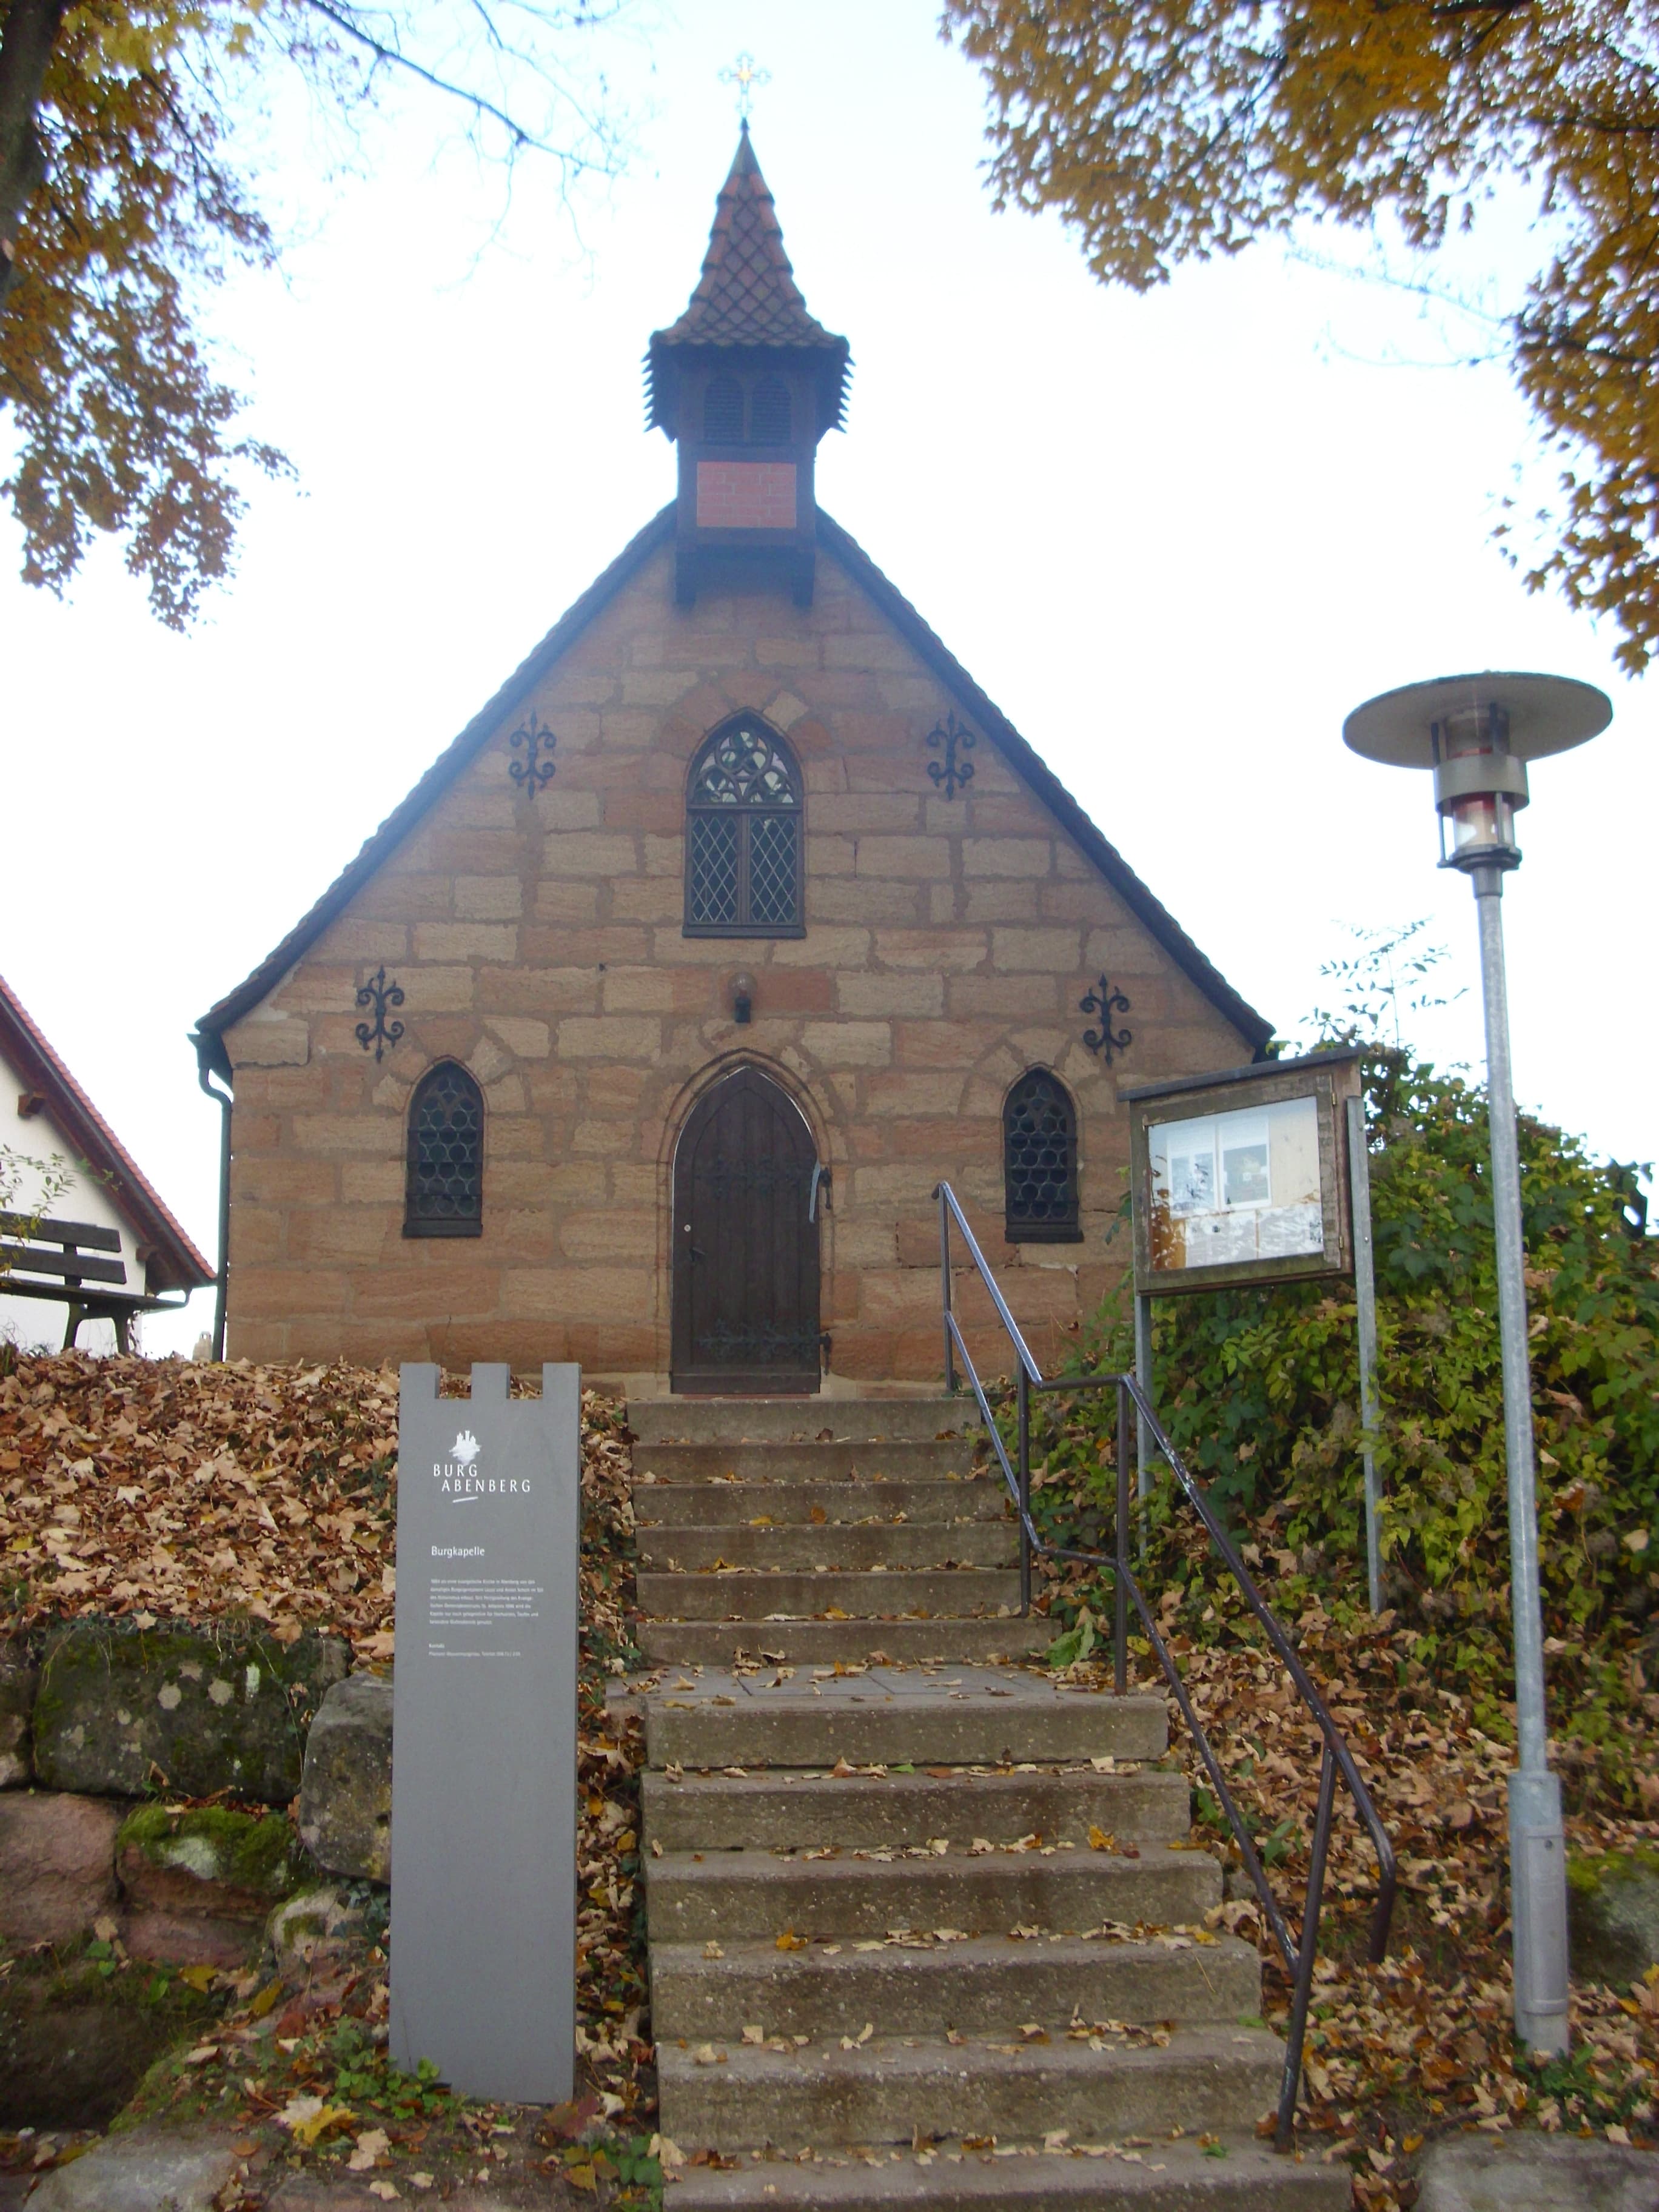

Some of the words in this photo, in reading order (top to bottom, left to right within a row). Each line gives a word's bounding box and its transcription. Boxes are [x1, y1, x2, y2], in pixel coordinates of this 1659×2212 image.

[434, 1464, 477, 1477] BURG
[441, 1479, 531, 1492] ABENBERG
[431, 1546, 485, 1558] Burgkapelle
